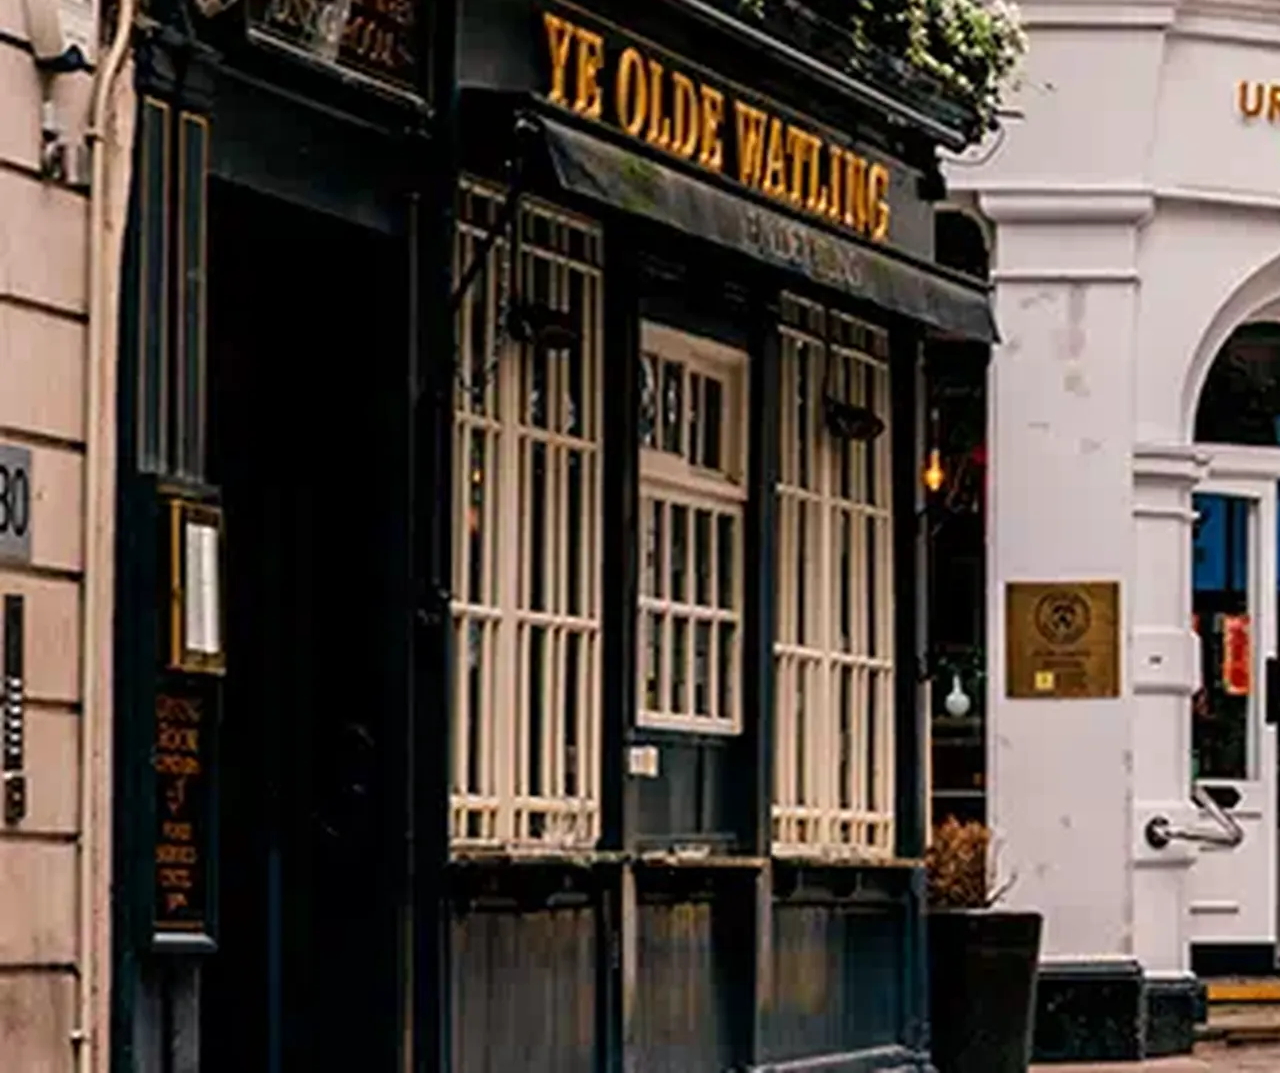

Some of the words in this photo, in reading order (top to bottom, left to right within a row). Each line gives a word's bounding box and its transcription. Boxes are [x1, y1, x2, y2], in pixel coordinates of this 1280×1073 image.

[543, 12, 604, 120] YE
[614, 47, 724, 174] OLDE
[734, 97, 890, 244] WATLING
